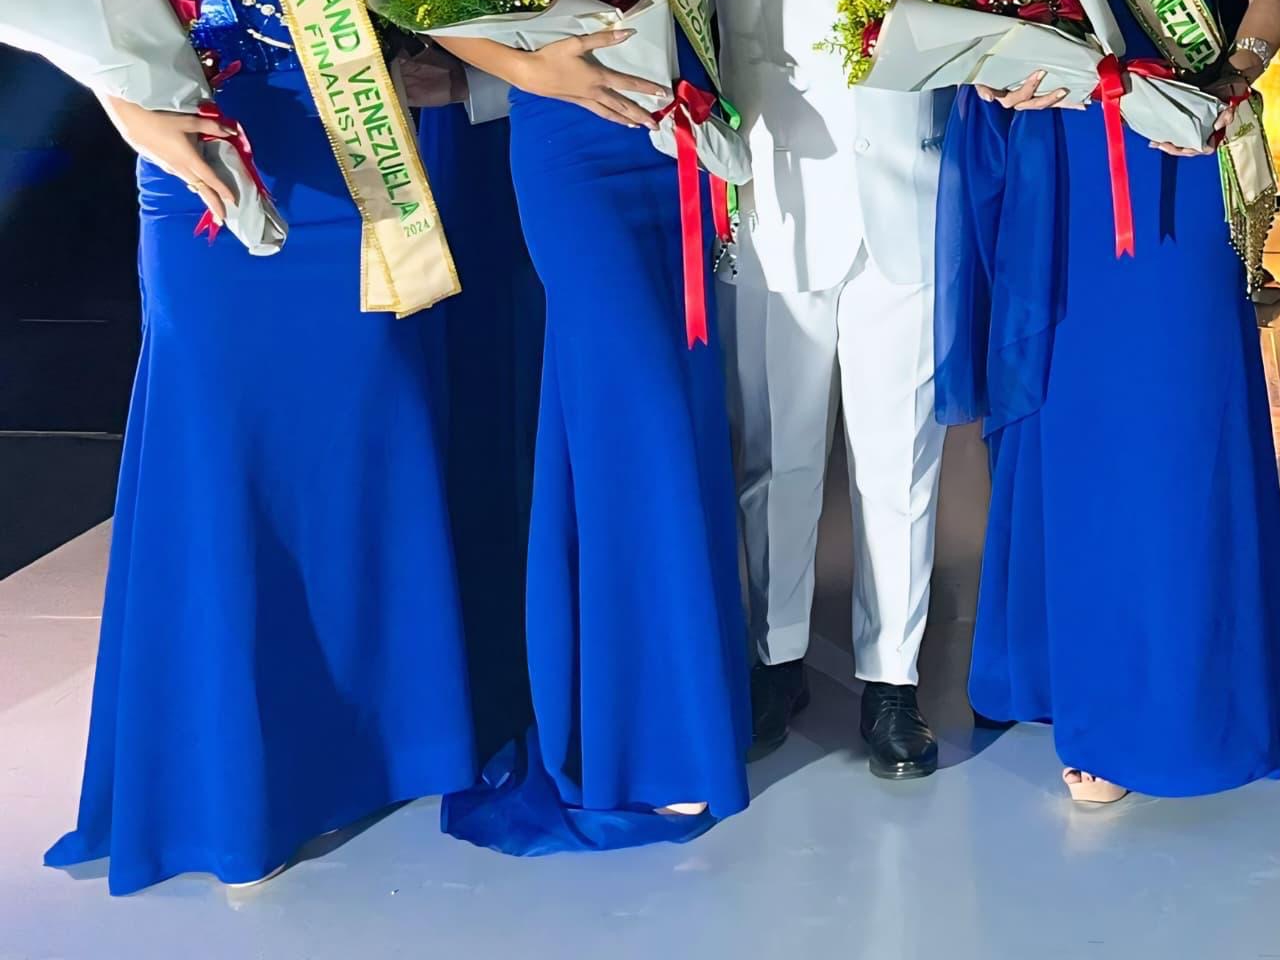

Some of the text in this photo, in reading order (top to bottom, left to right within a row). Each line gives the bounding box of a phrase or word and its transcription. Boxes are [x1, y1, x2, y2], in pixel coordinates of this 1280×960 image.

[304, 24, 367, 168] FINALISTA
[348, 65, 410, 221] VENEZUELA
[403, 220, 431, 238] 2024
